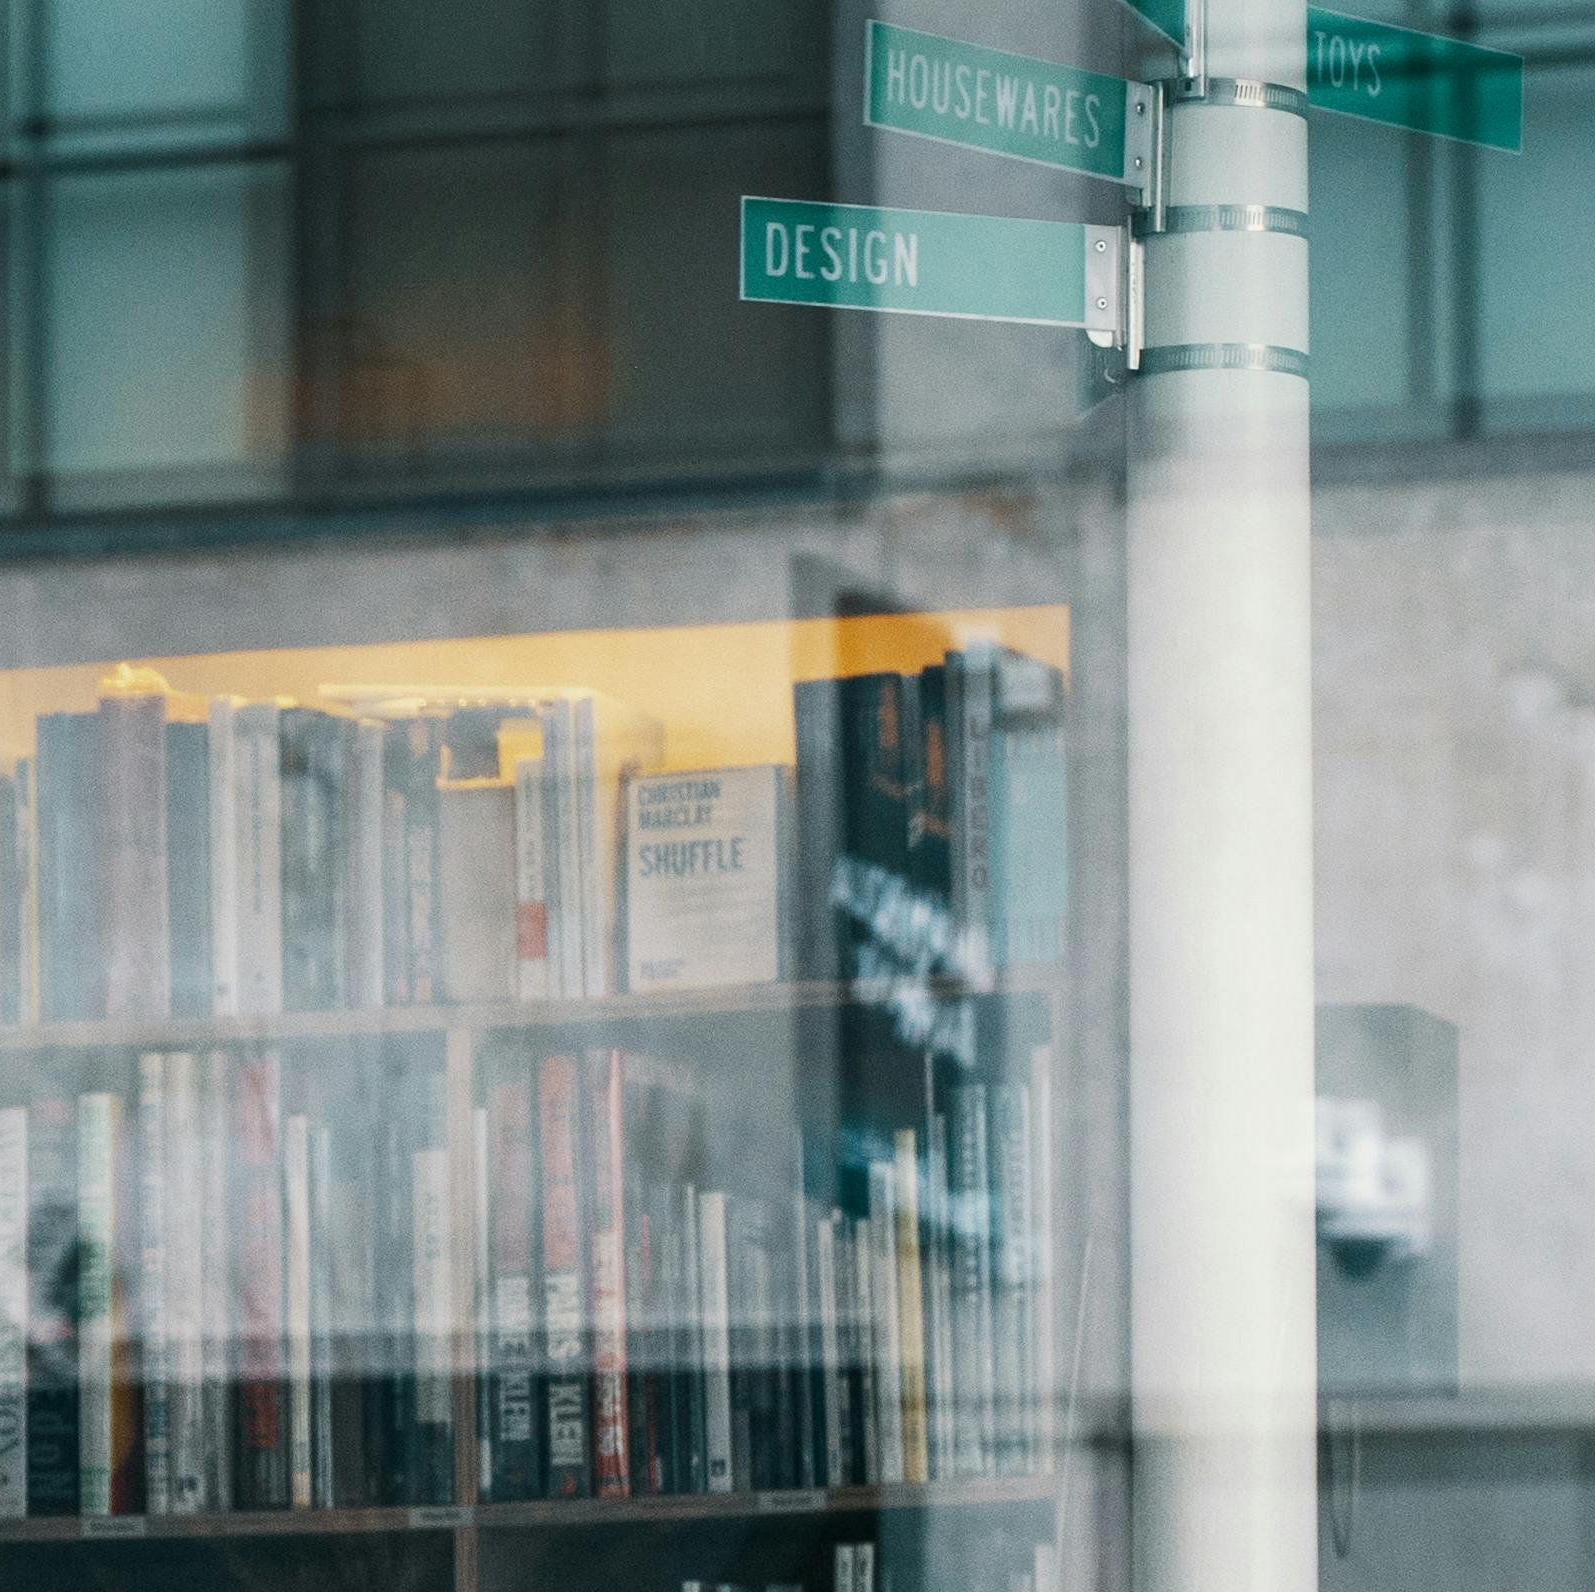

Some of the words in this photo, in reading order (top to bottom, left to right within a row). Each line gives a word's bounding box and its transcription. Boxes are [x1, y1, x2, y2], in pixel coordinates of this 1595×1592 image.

[884, 49, 1102, 149] HOUSEWARES
[1315, 30, 1383, 98] TOYS
[764, 220, 919, 289] DESIGN
[638, 836, 747, 879] SHUFFLE
[545, 1273, 581, 1360] PARIS
[548, 1382, 584, 1467] KLEIN
